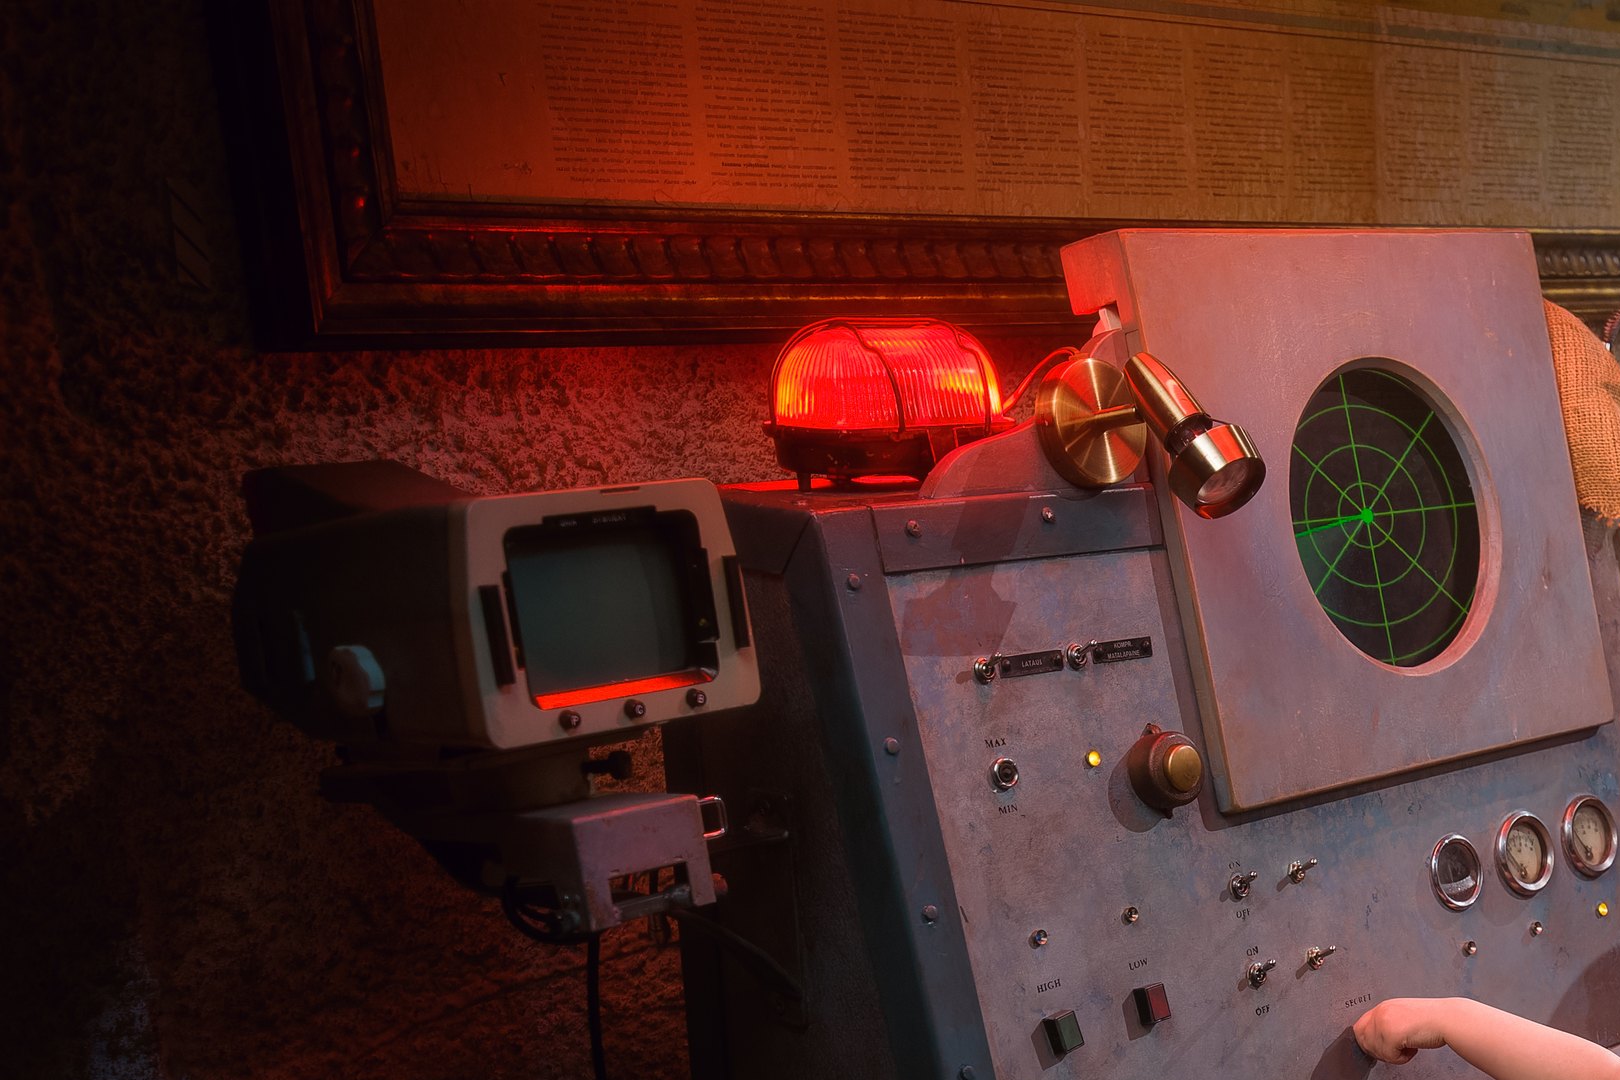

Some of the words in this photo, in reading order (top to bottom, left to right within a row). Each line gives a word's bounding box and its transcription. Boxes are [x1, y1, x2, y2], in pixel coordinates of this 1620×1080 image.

[1107, 649, 1140, 659] MATALAPAINE
[984, 738, 1007, 749] MAX
[998, 803, 1019, 815] MIN
[1236, 908, 1250, 919] OFF
[1246, 946, 1259, 957] ON
[1128, 957, 1149, 971] LOW
[1036, 978, 1062, 994] HIGH
[1344, 993, 1372, 1009] SECRET
[1255, 1004, 1271, 1016] OFF
